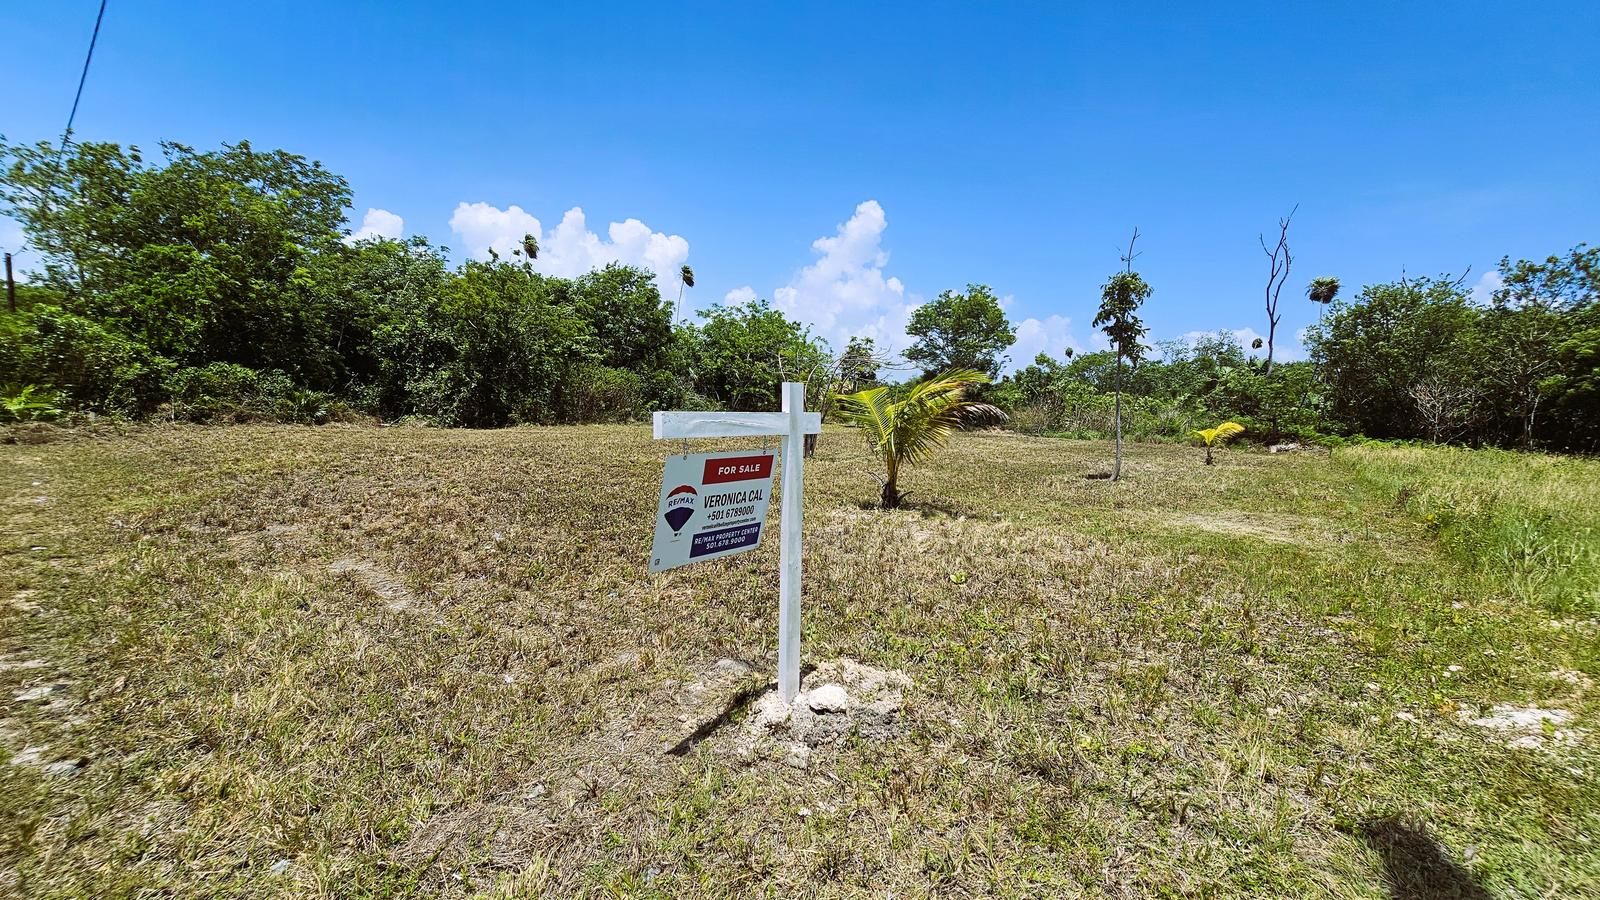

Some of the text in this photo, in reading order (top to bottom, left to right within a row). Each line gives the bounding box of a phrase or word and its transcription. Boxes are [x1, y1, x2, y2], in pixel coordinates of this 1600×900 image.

[718, 464, 760, 475] FOR SALE
[668, 498, 694, 507] RE/MAX
[704, 489, 763, 508] VERONICA CAL
[707, 506, 754, 520] +501 6789000
[694, 527, 758, 544] RE/MAX PROPERTY CENTER
